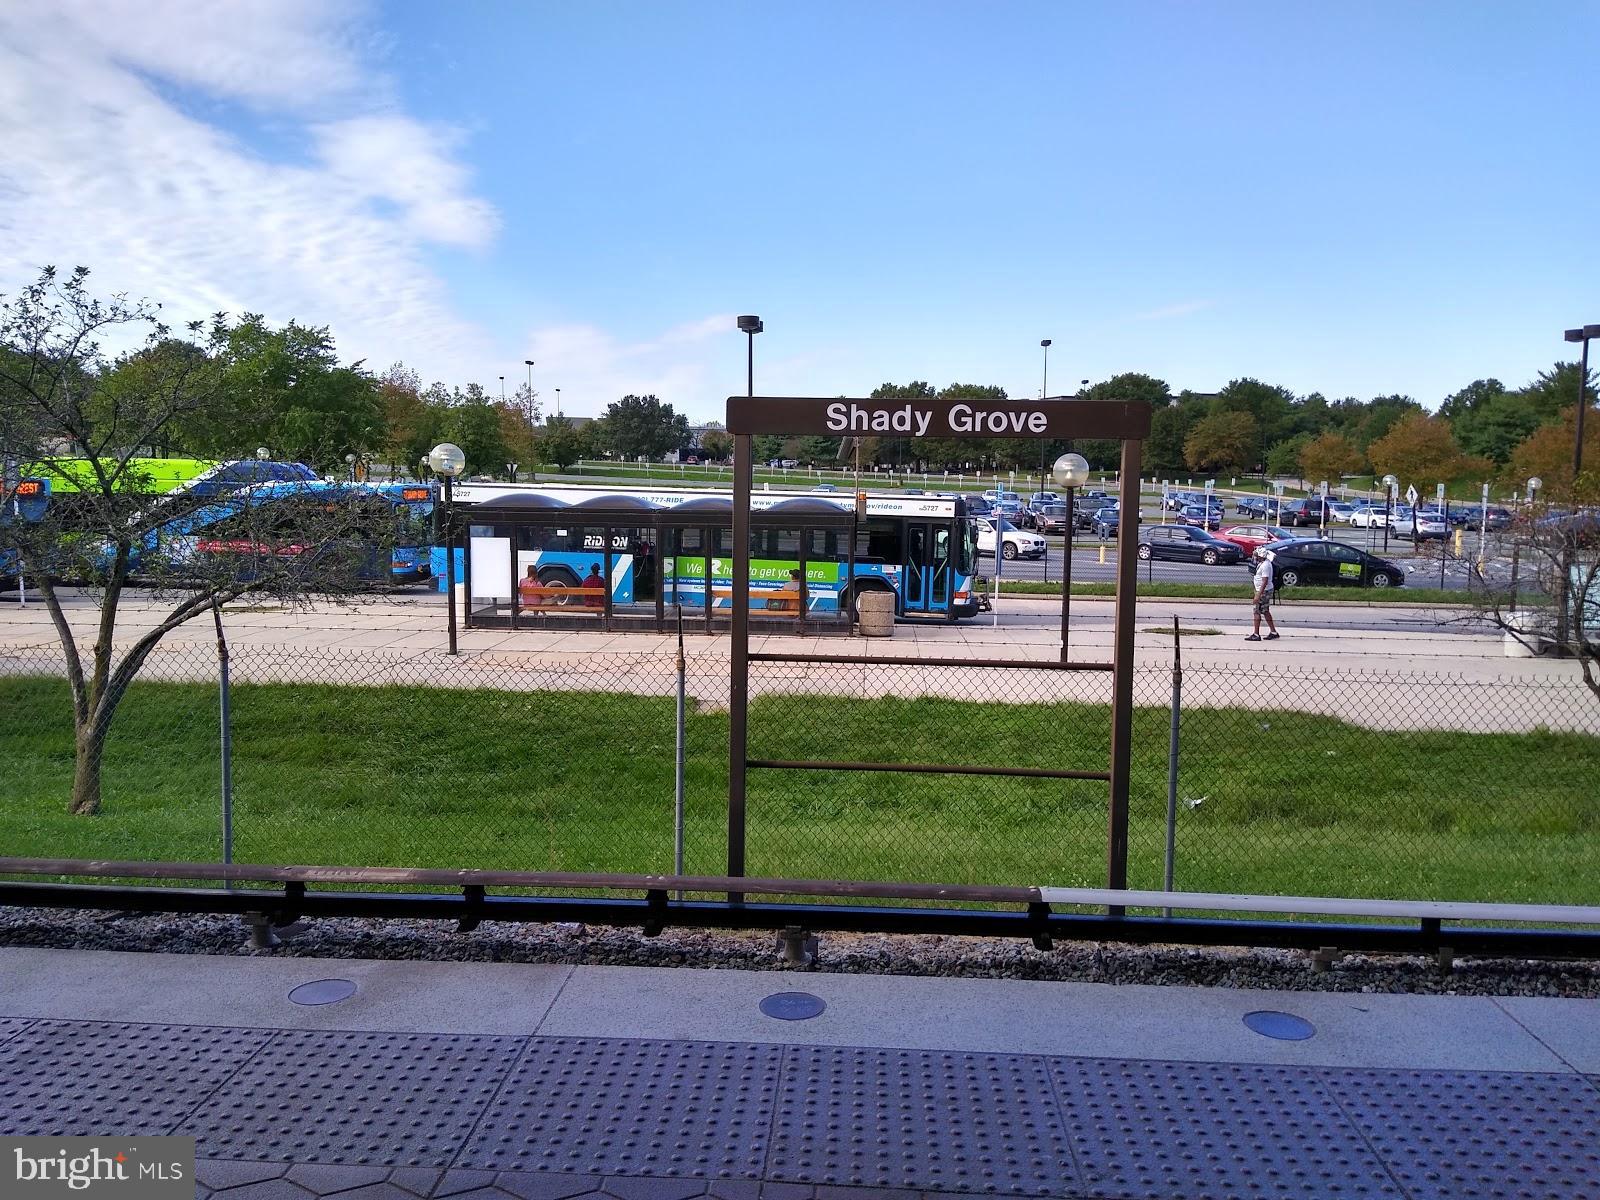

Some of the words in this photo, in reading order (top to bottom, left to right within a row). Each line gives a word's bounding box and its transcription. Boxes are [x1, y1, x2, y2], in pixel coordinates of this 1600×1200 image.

[826, 403, 932, 436] Shady
[948, 404, 1048, 433] Grove
[612, 536, 628, 547] ON
[686, 562, 703, 574] We
[759, 567, 776, 578] get
[777, 569, 792, 579] yo
